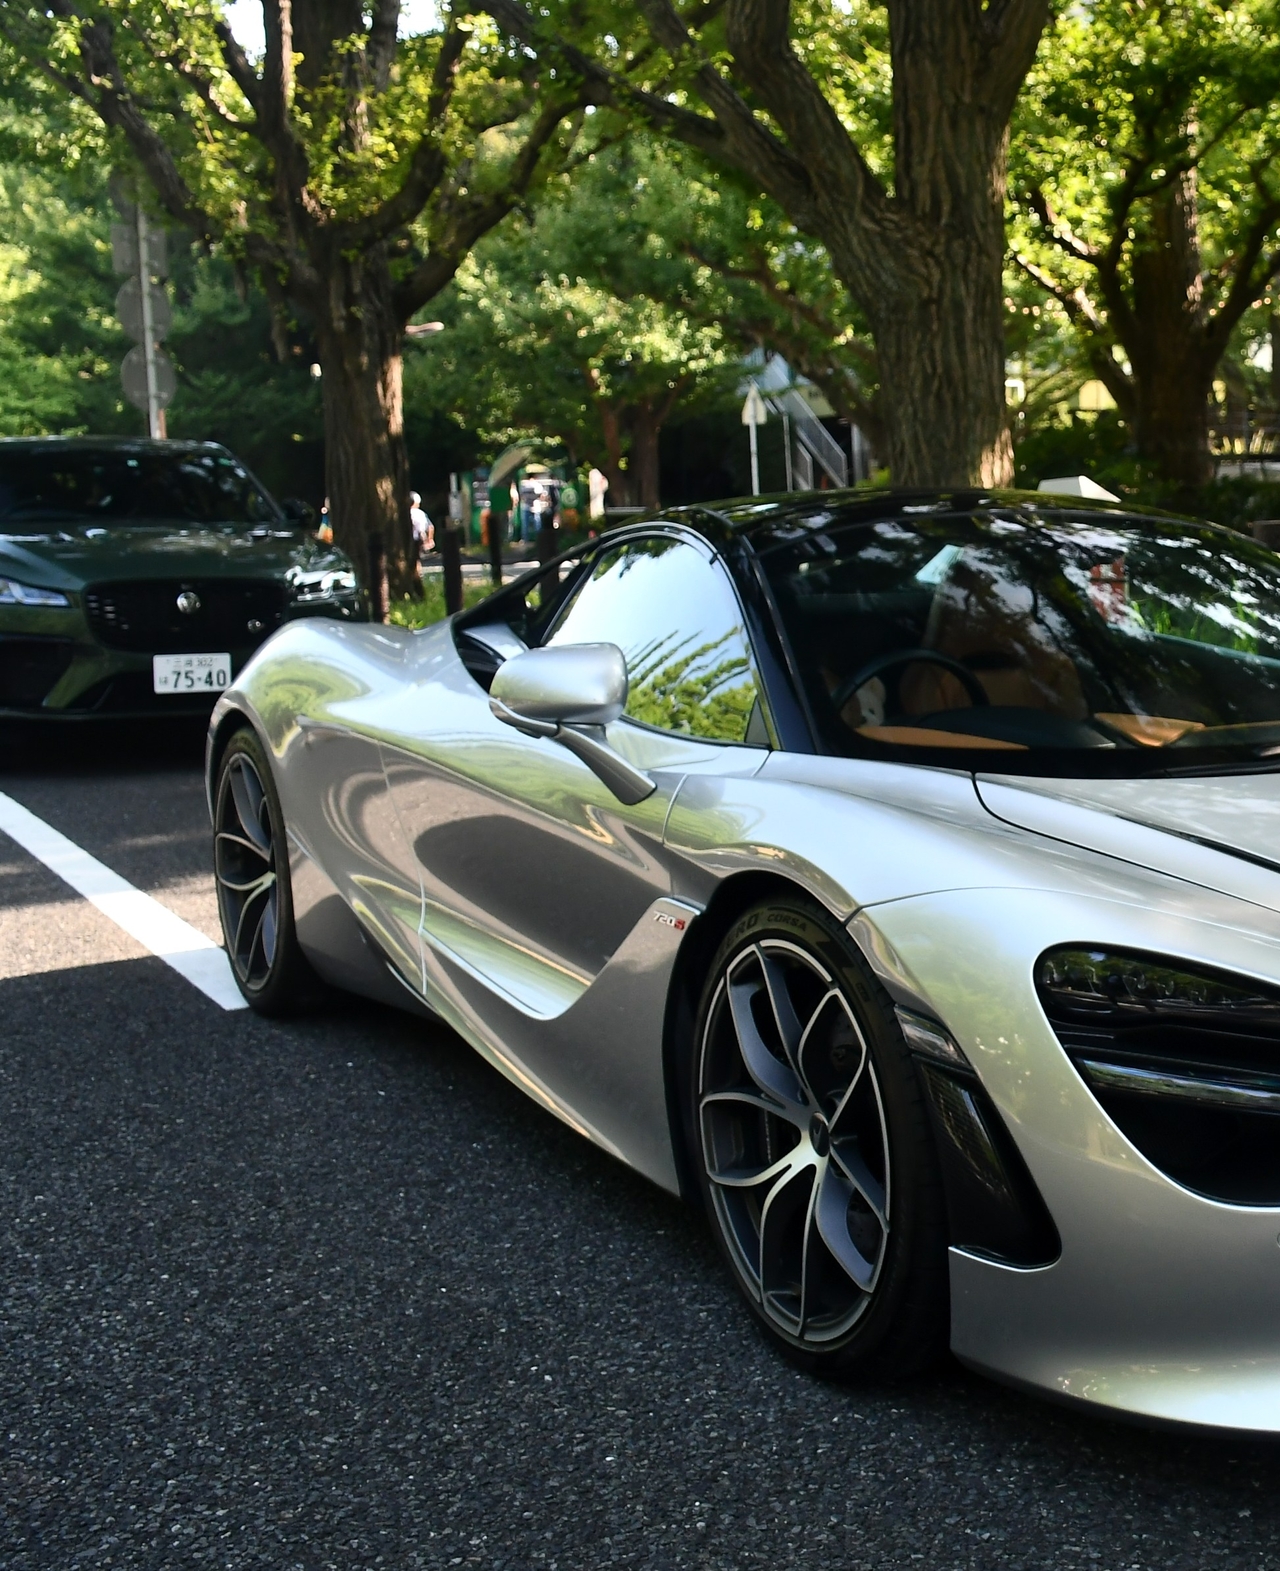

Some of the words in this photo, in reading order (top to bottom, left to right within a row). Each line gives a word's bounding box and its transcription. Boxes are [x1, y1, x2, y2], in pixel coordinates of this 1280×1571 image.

[172, 669, 227, 689] 75-40
[653, 911, 686, 931] 720S
[766, 912, 808, 932] CORSA
